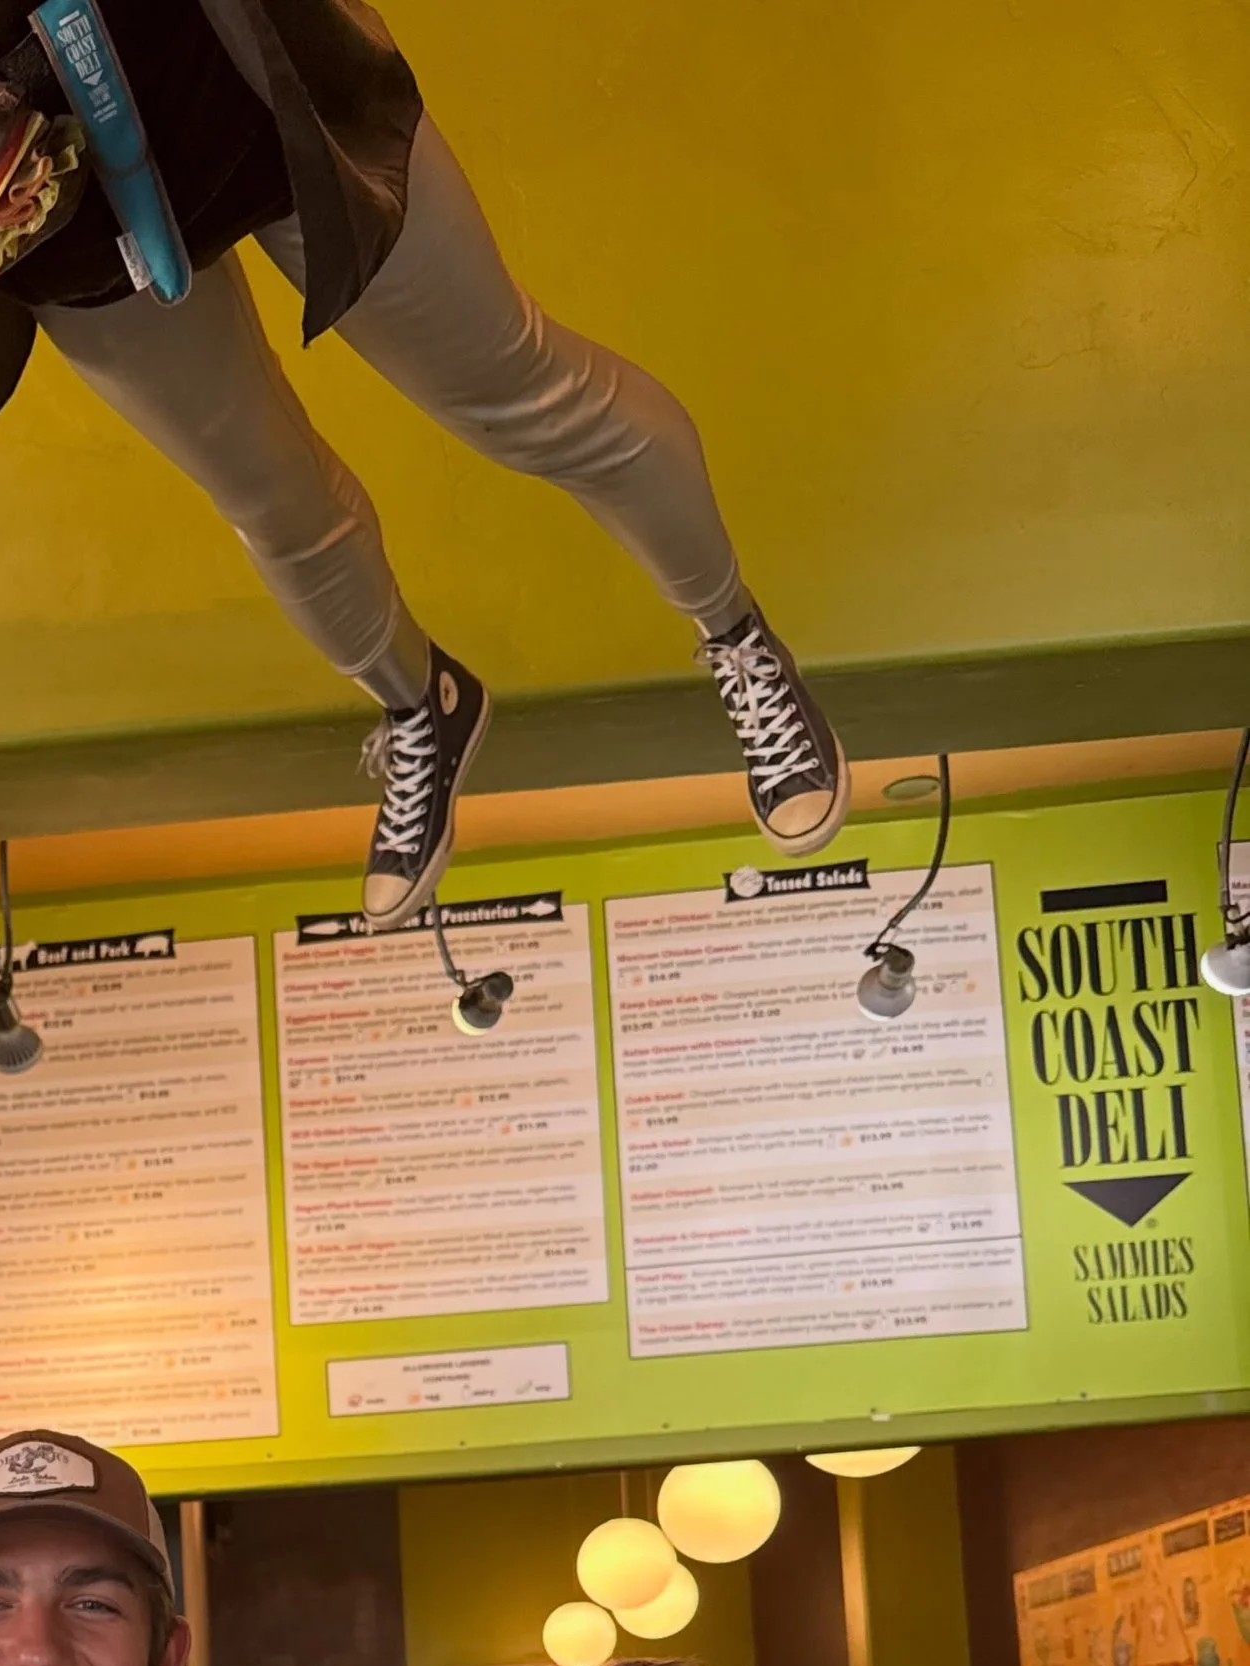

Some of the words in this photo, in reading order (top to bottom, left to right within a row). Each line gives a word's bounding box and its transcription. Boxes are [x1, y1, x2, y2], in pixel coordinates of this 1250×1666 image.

[57, 15, 92, 47] SOUTH
[65, 33, 97, 64] COAST
[75, 51, 101, 80] DELI
[766, 872, 811, 892] Tossed
[816, 866, 862, 887] Salads
[442, 906, 517, 924] Pescatarian
[37, 948, 68, 964] Beef
[72, 945, 96, 962] and
[100, 942, 131, 959] Pork
[1017, 913, 1203, 1003] SOUTH
[1031, 997, 1201, 1086] COAST
[1055, 1083, 1196, 1169] DELI
[1073, 1237, 1195, 1282] SAMMIES
[1087, 1280, 1189, 1325] SALADS
